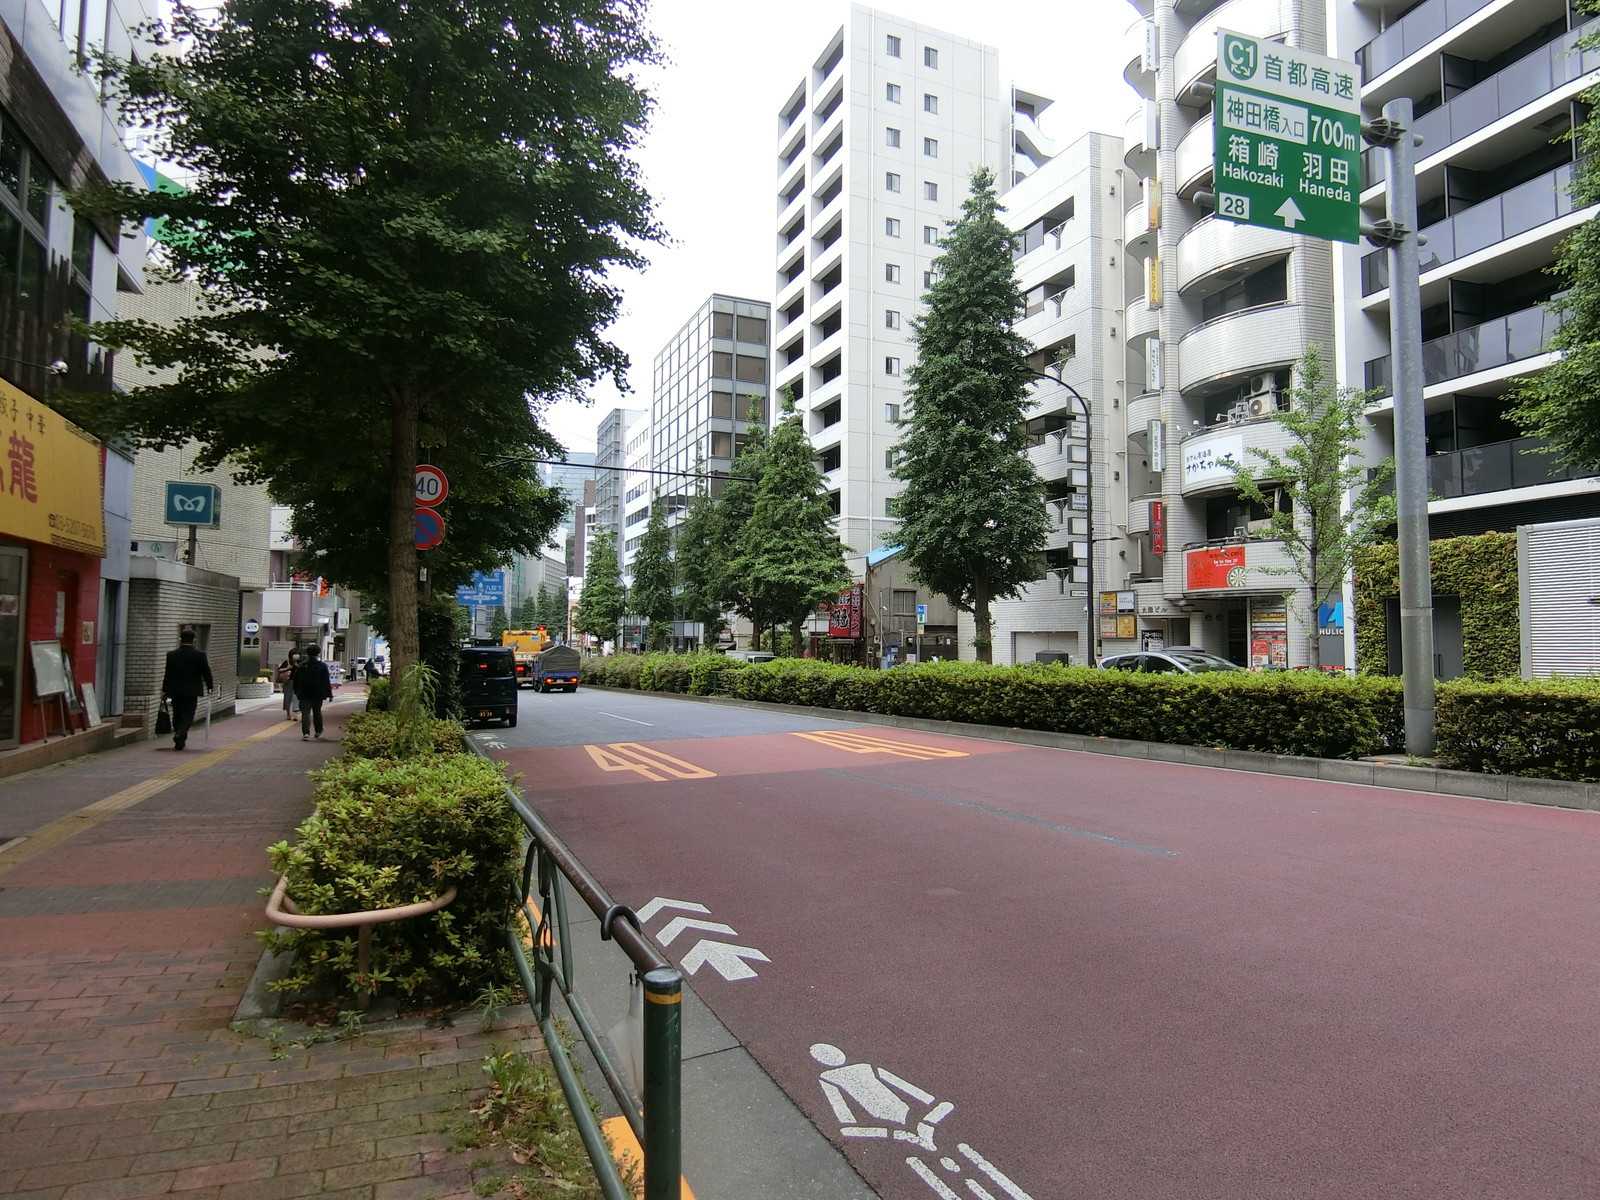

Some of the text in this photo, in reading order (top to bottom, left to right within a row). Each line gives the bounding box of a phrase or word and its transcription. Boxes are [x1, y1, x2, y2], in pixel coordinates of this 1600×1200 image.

[1228, 40, 1254, 68] C1
[1263, 53, 1354, 101] 首都高速
[1226, 96, 1355, 151] 神田橋入口 700m
[1222, 162, 1351, 202] Hakozaki Haneda
[1228, 134, 1349, 186] 箱崎 羽田
[1224, 196, 1245, 215] 28
[0, 429, 38, 503] 龍
[415, 476, 439, 496] 40
